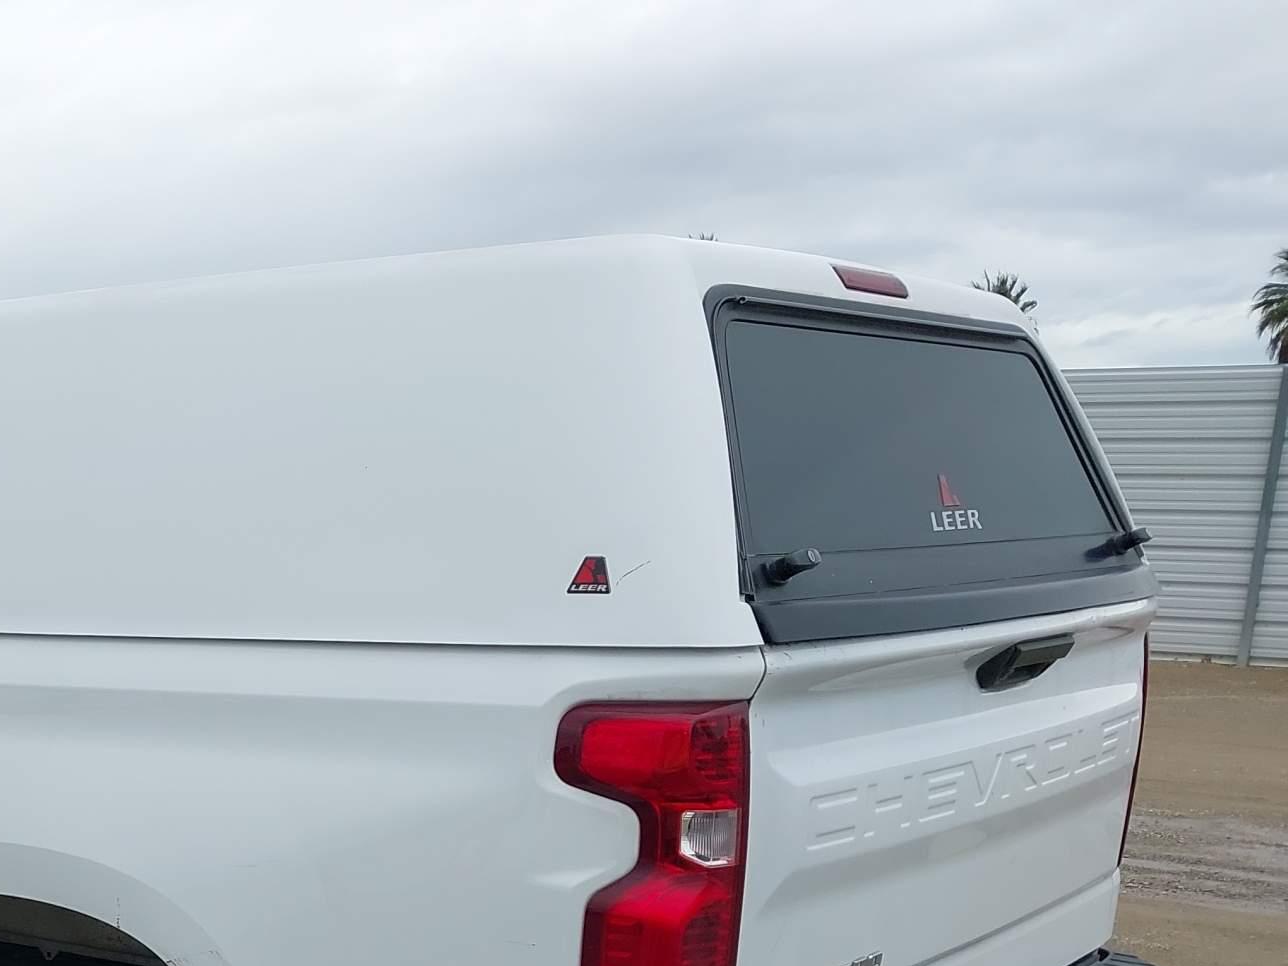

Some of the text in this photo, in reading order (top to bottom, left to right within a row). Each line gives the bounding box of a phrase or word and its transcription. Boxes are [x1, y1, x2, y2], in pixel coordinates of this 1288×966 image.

[930, 509, 983, 532] LEER
[569, 583, 608, 592] LEER
[806, 711, 1140, 851] CHEVROLET
